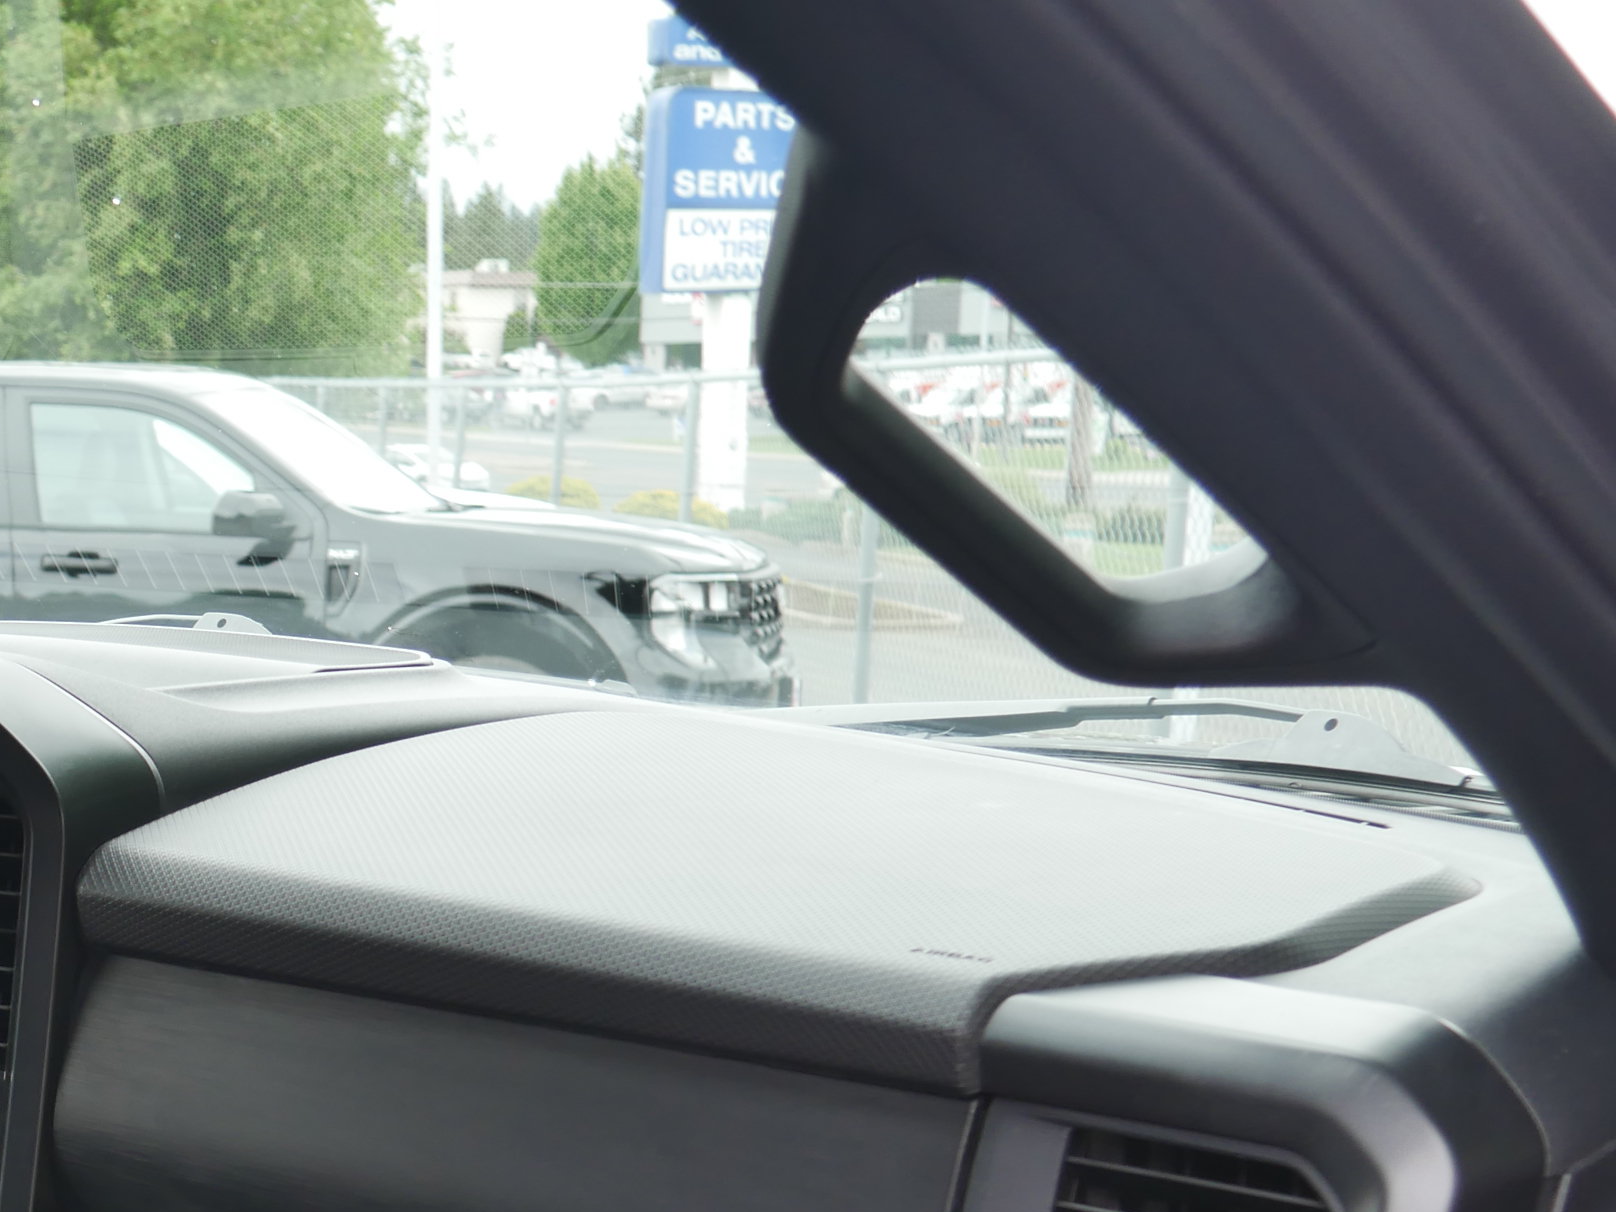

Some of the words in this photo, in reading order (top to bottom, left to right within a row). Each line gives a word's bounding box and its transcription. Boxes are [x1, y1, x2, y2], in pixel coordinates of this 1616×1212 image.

[694, 100, 796, 131] PARTS
[733, 135, 756, 165] &
[674, 168, 784, 198] SERVIC
[679, 217, 731, 236] LOW
[671, 262, 763, 281] GUARAN
